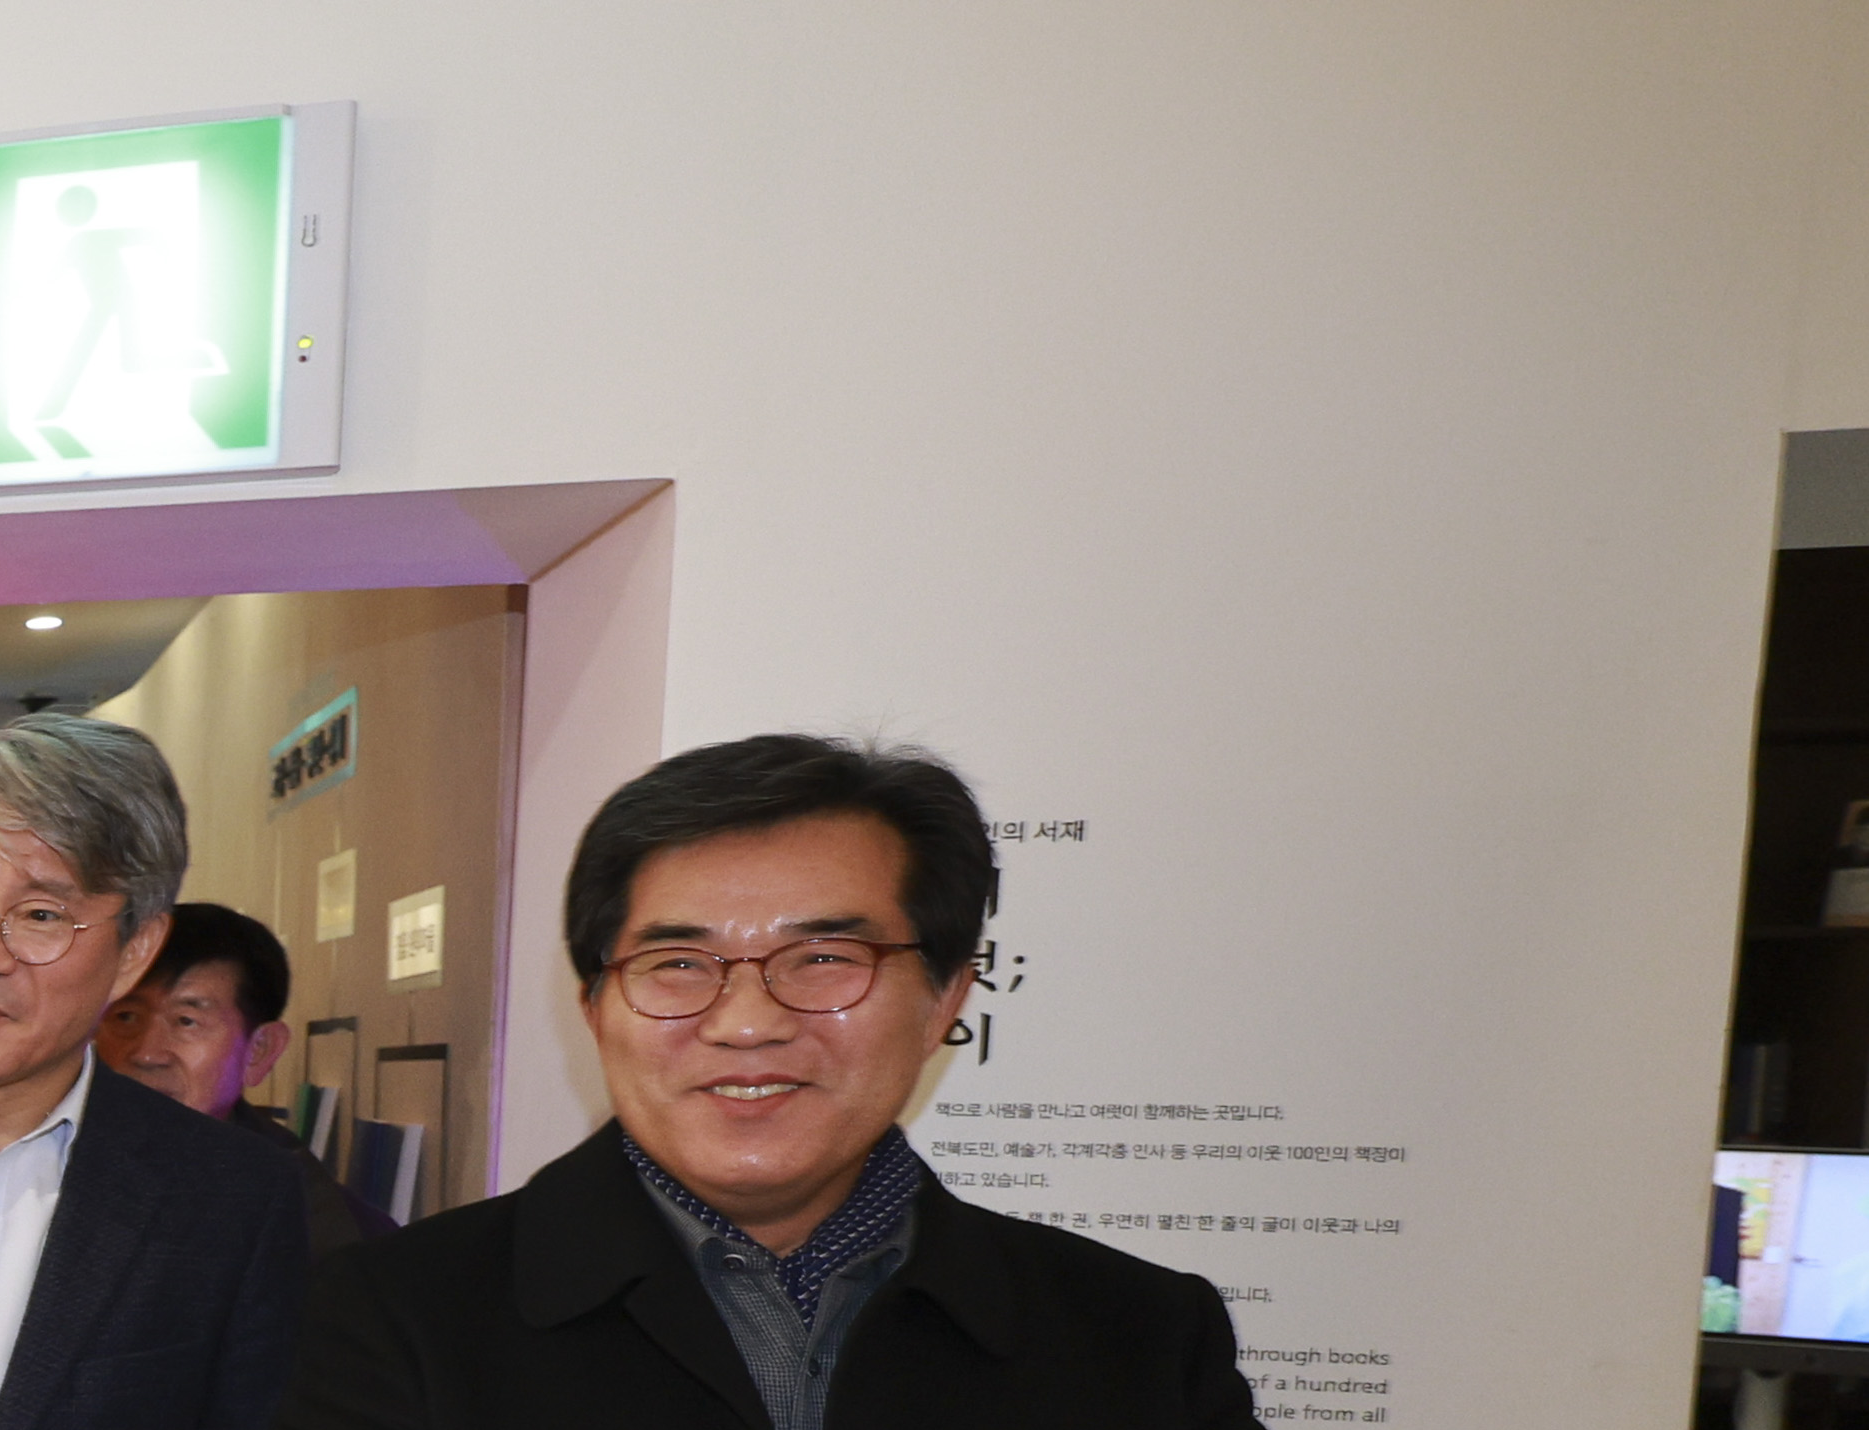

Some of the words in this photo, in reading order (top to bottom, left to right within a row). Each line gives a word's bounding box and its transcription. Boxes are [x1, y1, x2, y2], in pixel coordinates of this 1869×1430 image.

[1033, 820, 1086, 842] 서재
[935, 1102, 980, 1118] 책으로
[987, 1103, 1034, 1119] 사람을
[1037, 1104, 1086, 1119] 만나고
[1090, 1104, 1138, 1119] 여럿이
[1143, 1104, 1209, 1121] 함께하는
[1213, 1105, 1284, 1121] 곳입니다.
[930, 1141, 999, 1158] 전북도민,
[1003, 1142, 1057, 1158] 예술가,
[1062, 1143, 1128, 1160] 각계각층
[1132, 1144, 1165, 1159] 인사
[1171, 1144, 1187, 1160] 등
[1192, 1144, 1242, 1161] 우리의
[1247, 1145, 1281, 1161] 이웃
[1287, 1146, 1348, 1162] 100인의
[1353, 1146, 1405, 1163] 책장이
[980, 1173, 1050, 1188] 있습니다.
[1239, 1345, 1321, 1366] through
[1329, 1348, 1390, 1366] books
[1275, 1379, 1286, 1390] a
[1295, 1376, 1388, 1395] hundred
[1303, 1405, 1354, 1422] from
[1362, 1407, 1386, 1424] all
